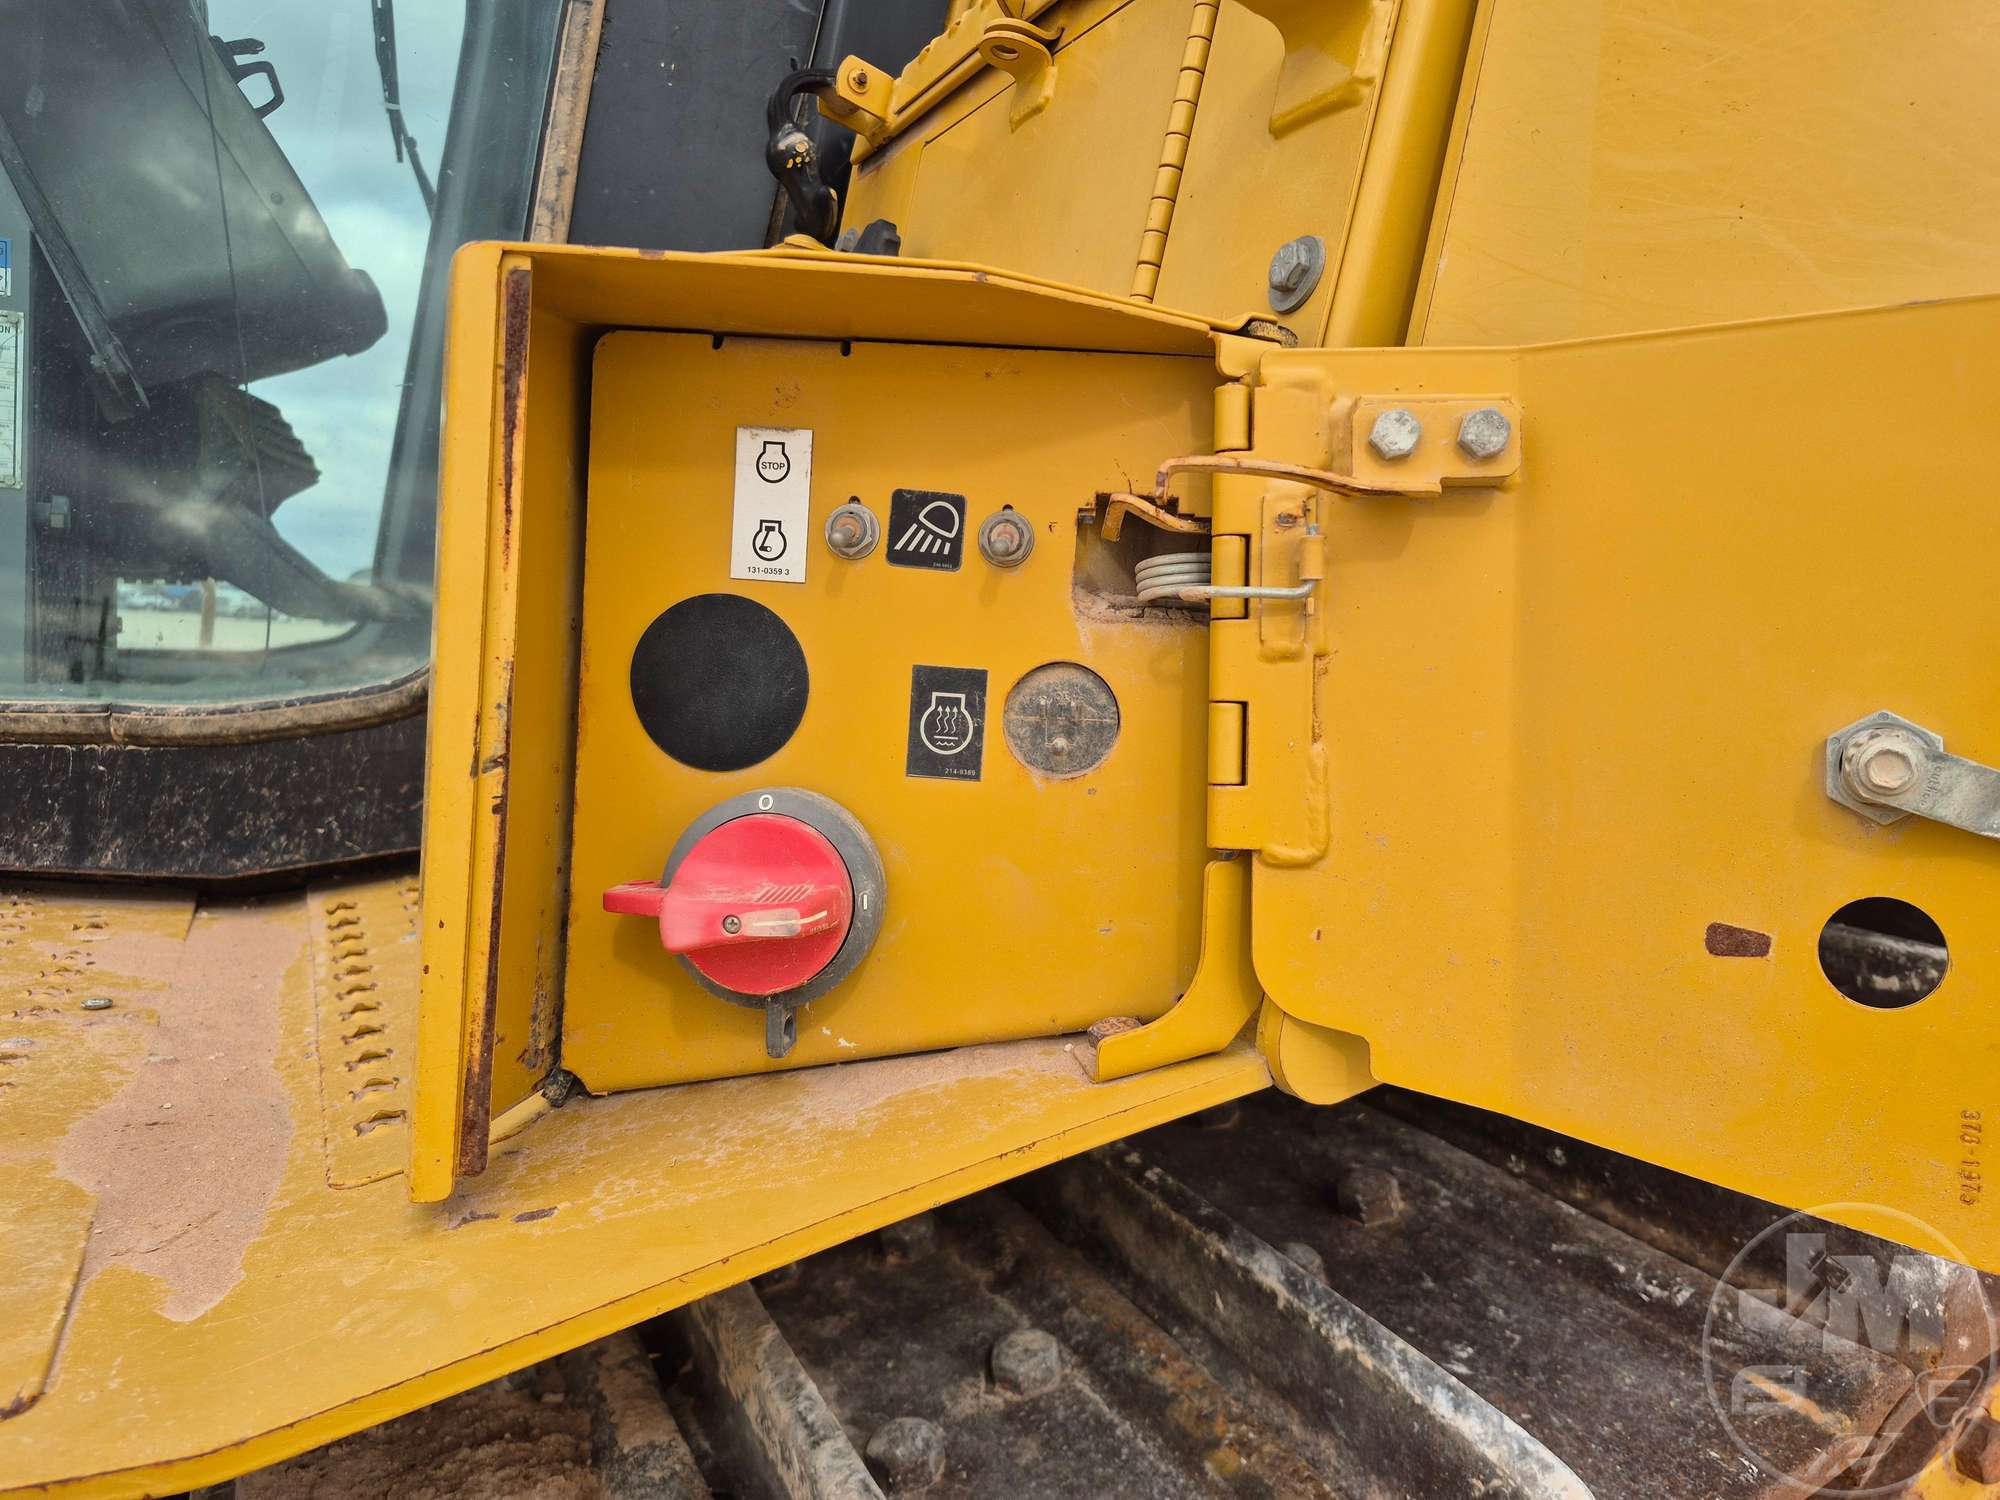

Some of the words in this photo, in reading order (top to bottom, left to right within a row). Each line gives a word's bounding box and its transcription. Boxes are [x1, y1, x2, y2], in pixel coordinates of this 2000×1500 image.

[761, 461, 785, 471] STOP
[747, 566, 783, 575] 131-0359
[784, 568, 790, 576] 3
